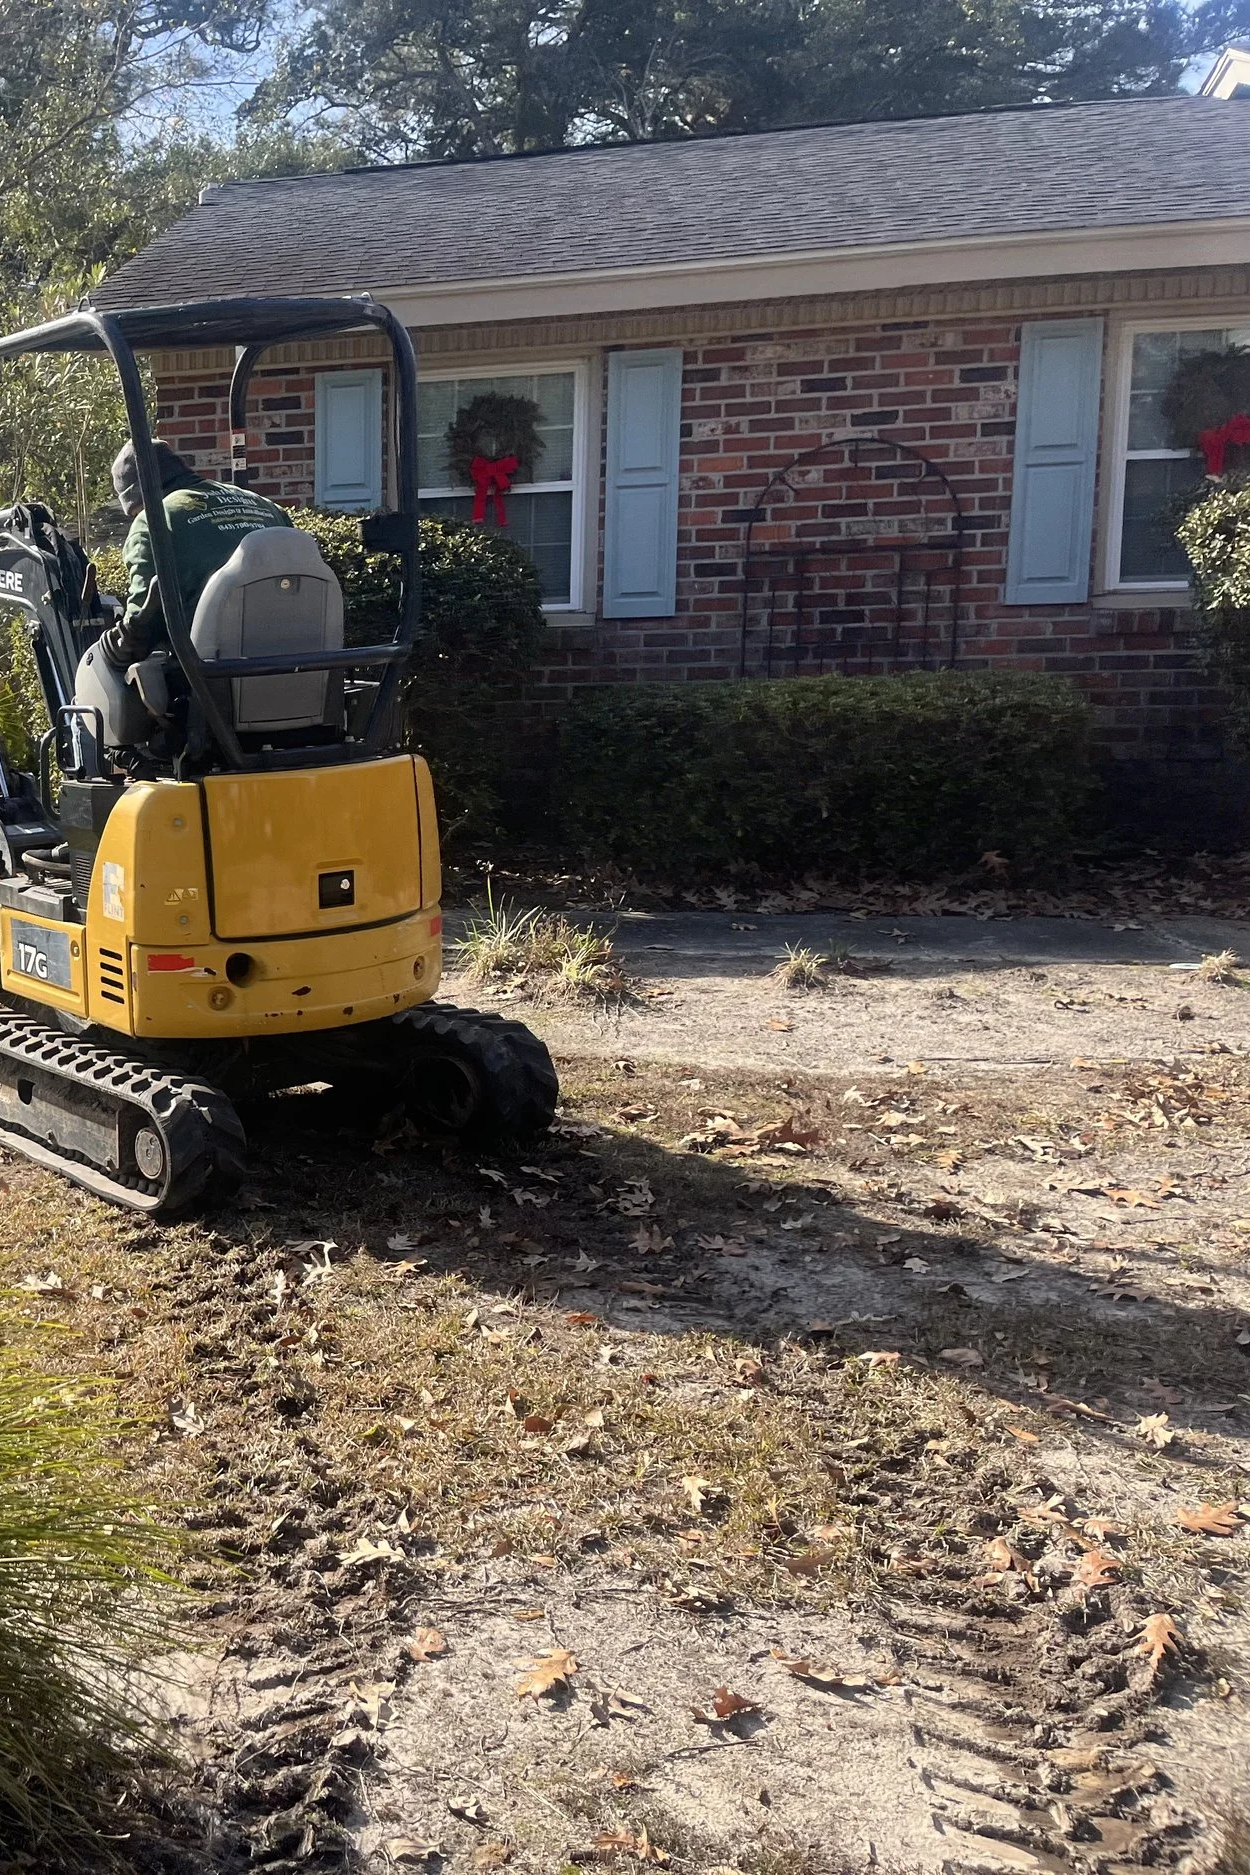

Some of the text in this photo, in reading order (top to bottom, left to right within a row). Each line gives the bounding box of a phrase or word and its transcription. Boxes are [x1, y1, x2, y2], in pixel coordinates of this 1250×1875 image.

[187, 510, 212, 525] Garden
[105, 903, 124, 918] FLINT
[18, 942, 48, 979] 17G
